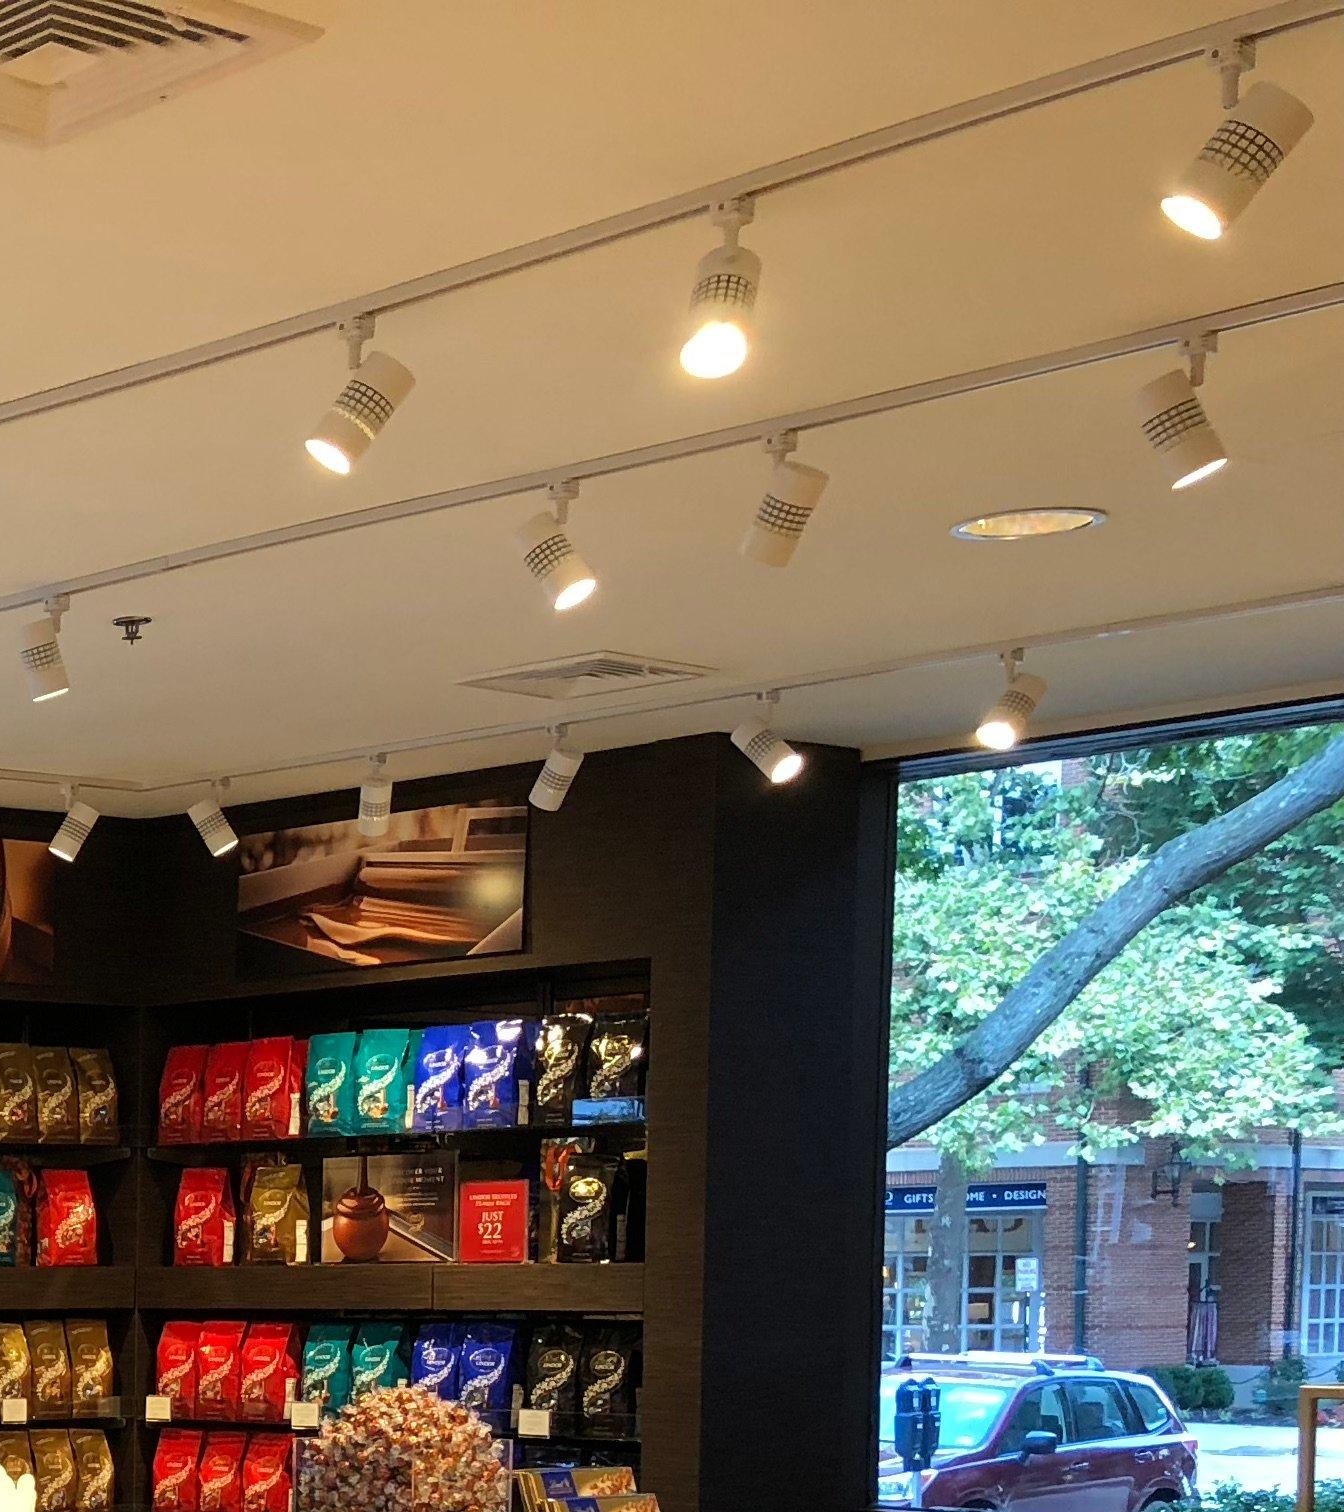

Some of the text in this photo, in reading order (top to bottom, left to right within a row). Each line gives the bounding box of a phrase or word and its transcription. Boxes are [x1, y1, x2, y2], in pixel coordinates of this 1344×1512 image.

[904, 1193, 934, 1204] GIFTS
[965, 1191, 985, 1202] ME
[1004, 1189, 1047, 1201] DESIGN
[481, 1211, 505, 1222] JUST
[477, 1222, 502, 1239] $22
